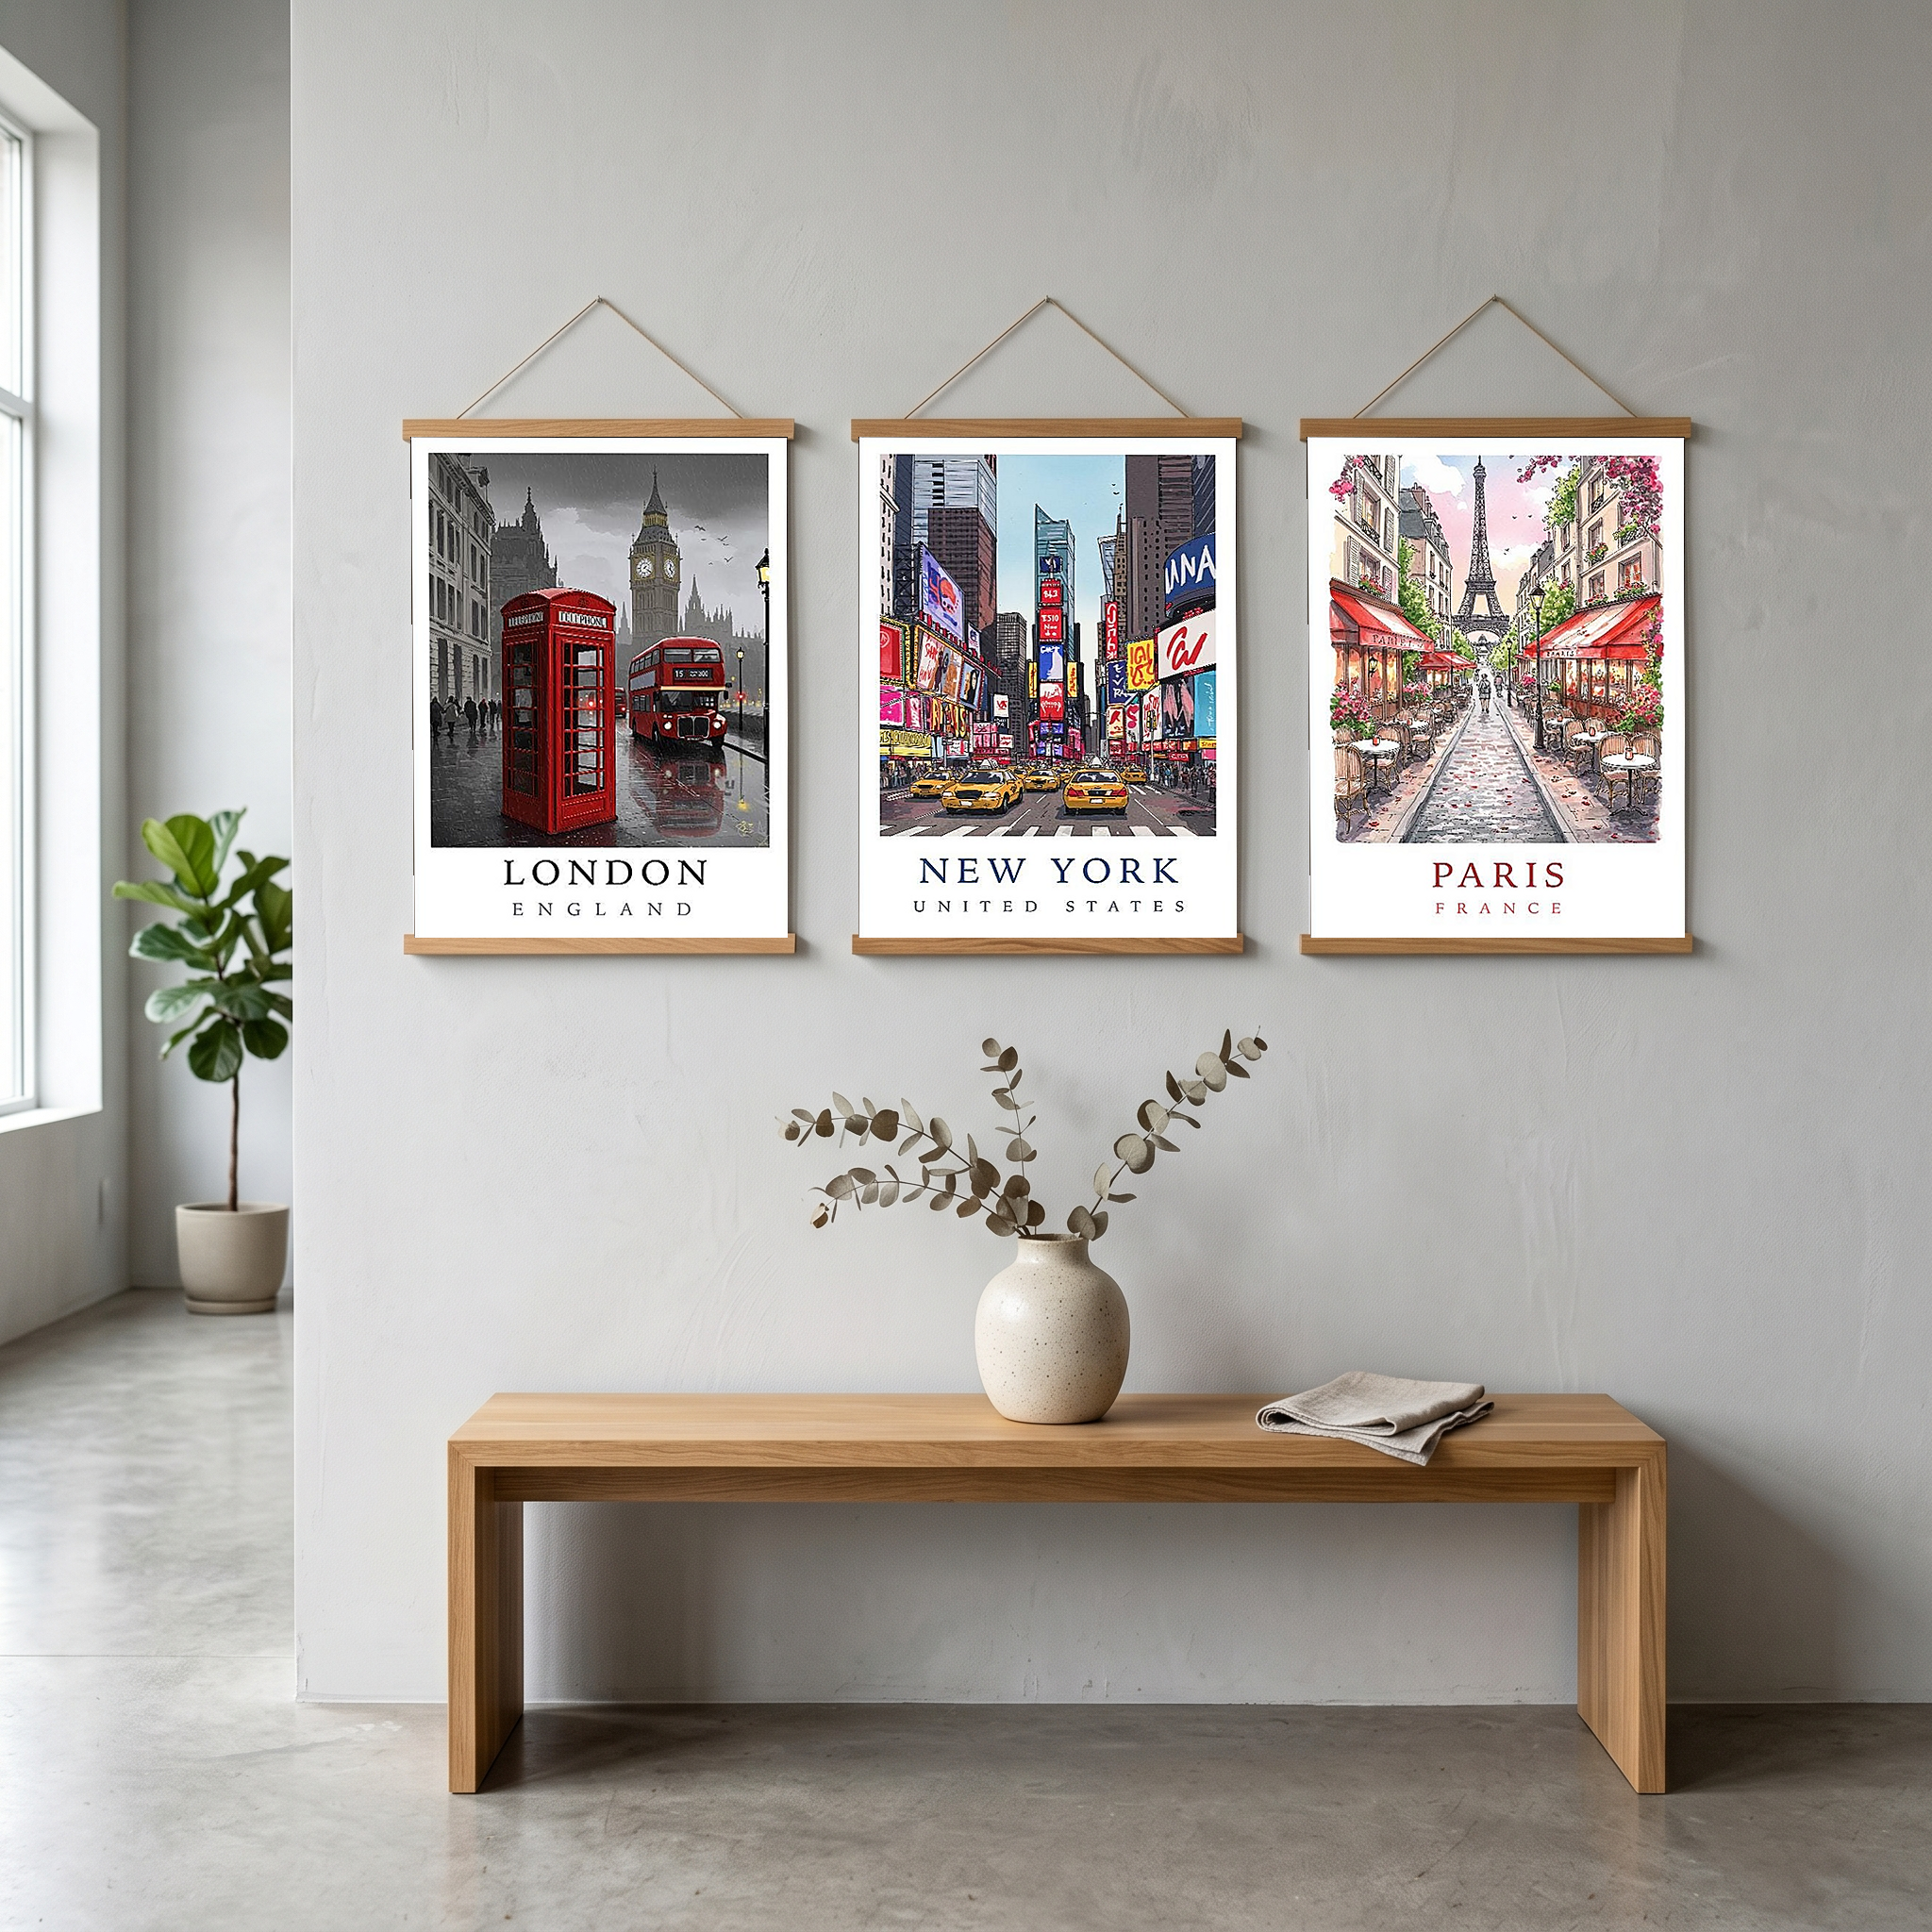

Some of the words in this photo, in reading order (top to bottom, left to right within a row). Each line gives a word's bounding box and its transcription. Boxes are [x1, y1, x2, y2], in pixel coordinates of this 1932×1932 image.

[508, 611, 543, 627] TELEPHON
[560, 611, 607, 629] TELEPHON
[504, 860, 708, 887] LONDON
[920, 858, 1026, 884] NEW
[1051, 858, 1179, 884] YORK
[1433, 862, 1564, 889] PARIS
[513, 902, 691, 917] ENGLAND
[913, 900, 1038, 913] UNITED
[1066, 900, 1185, 913] STATES
[1436, 902, 1561, 915] FRANCE
